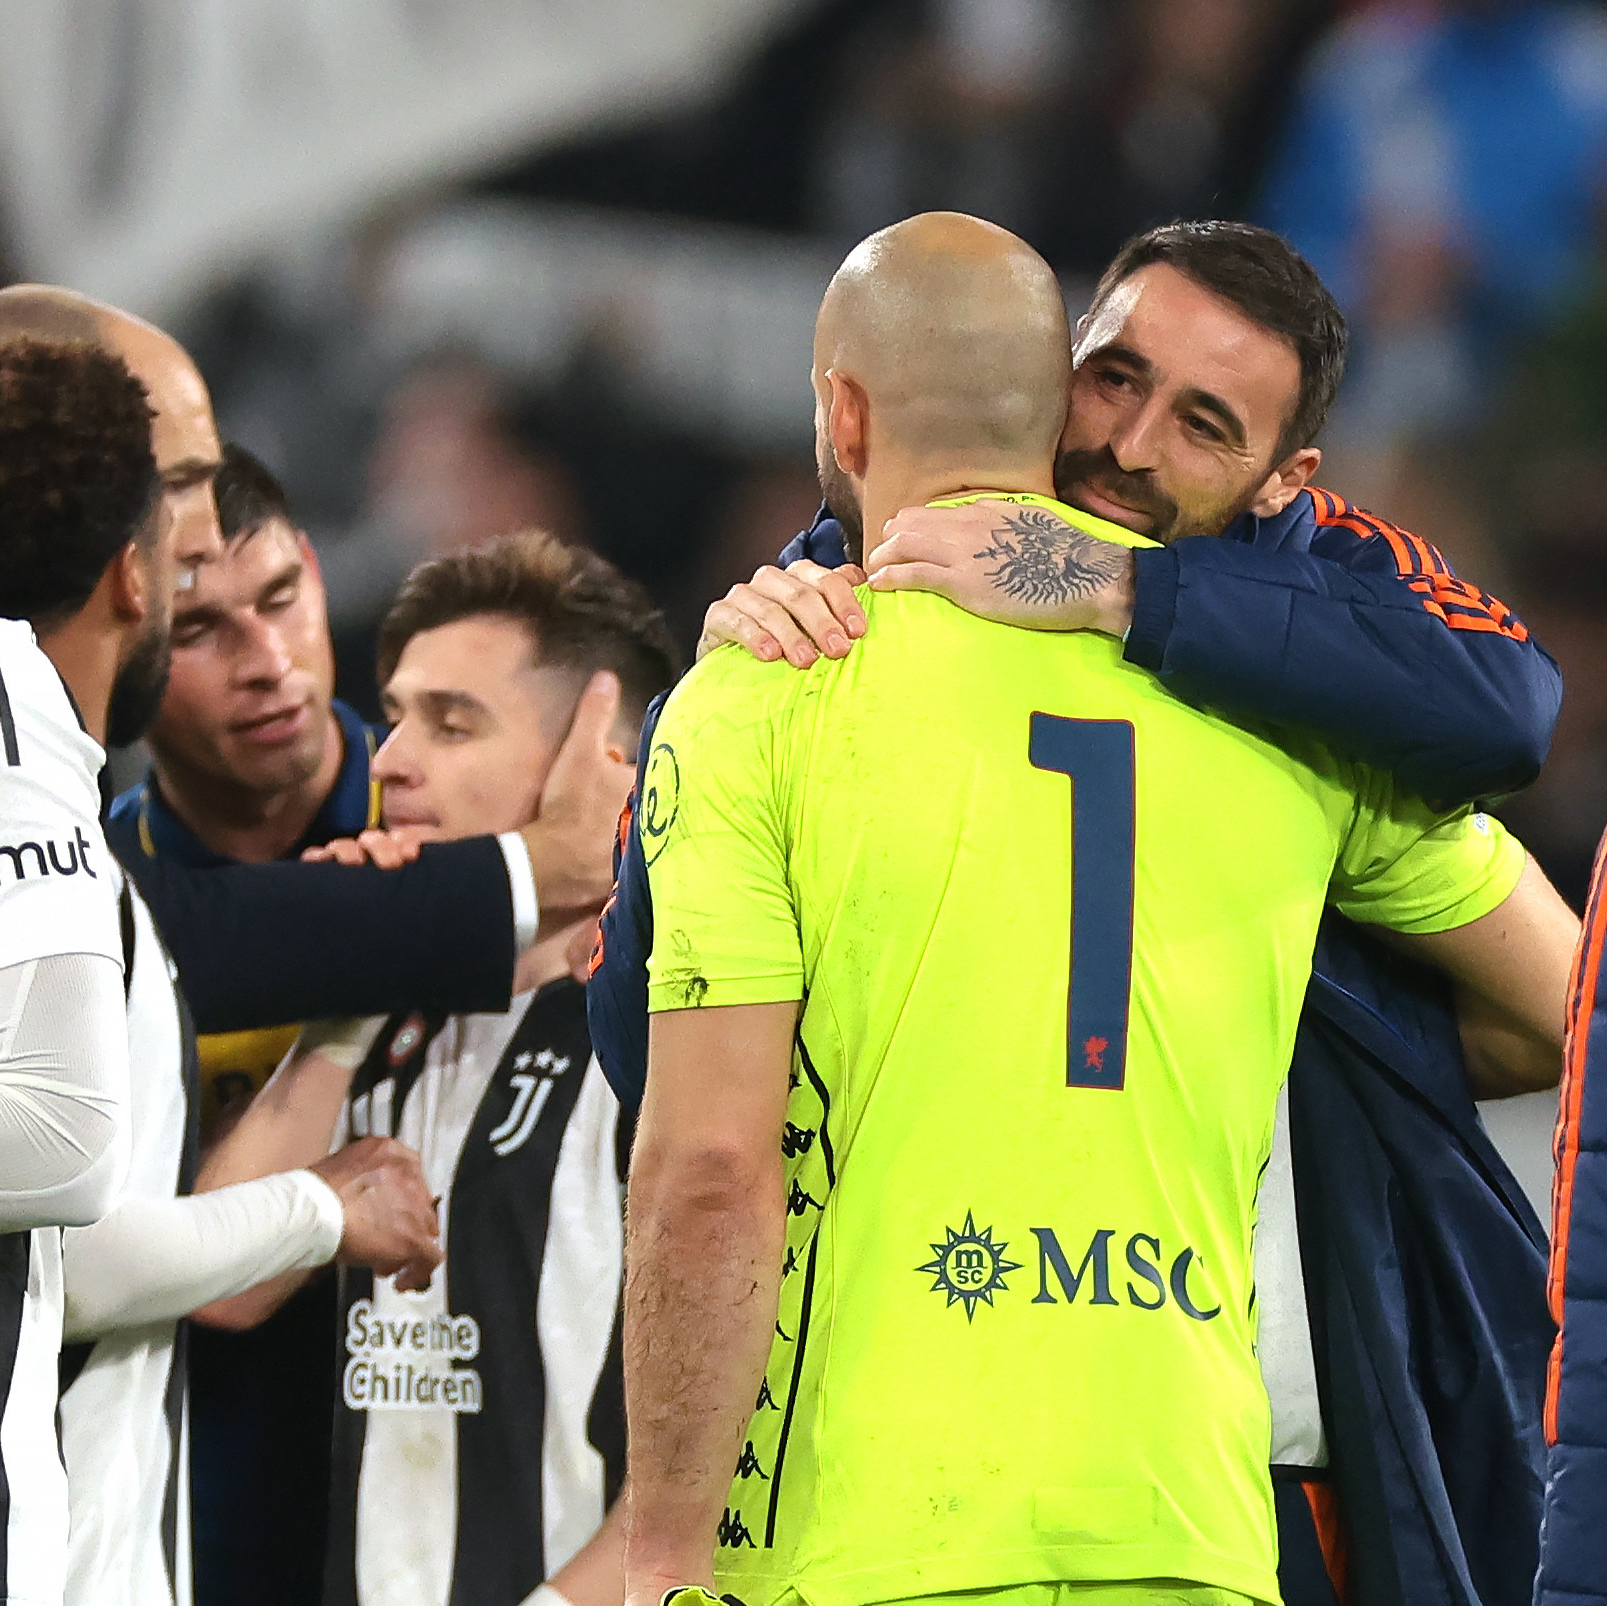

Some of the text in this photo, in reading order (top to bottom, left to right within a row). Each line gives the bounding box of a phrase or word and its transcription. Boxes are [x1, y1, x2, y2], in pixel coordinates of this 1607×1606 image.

[1027, 711, 1136, 1090] 1
[1029, 1226, 1222, 1322] MSC
[351, 1307, 426, 1351] Save
[348, 1361, 478, 1405] Children
